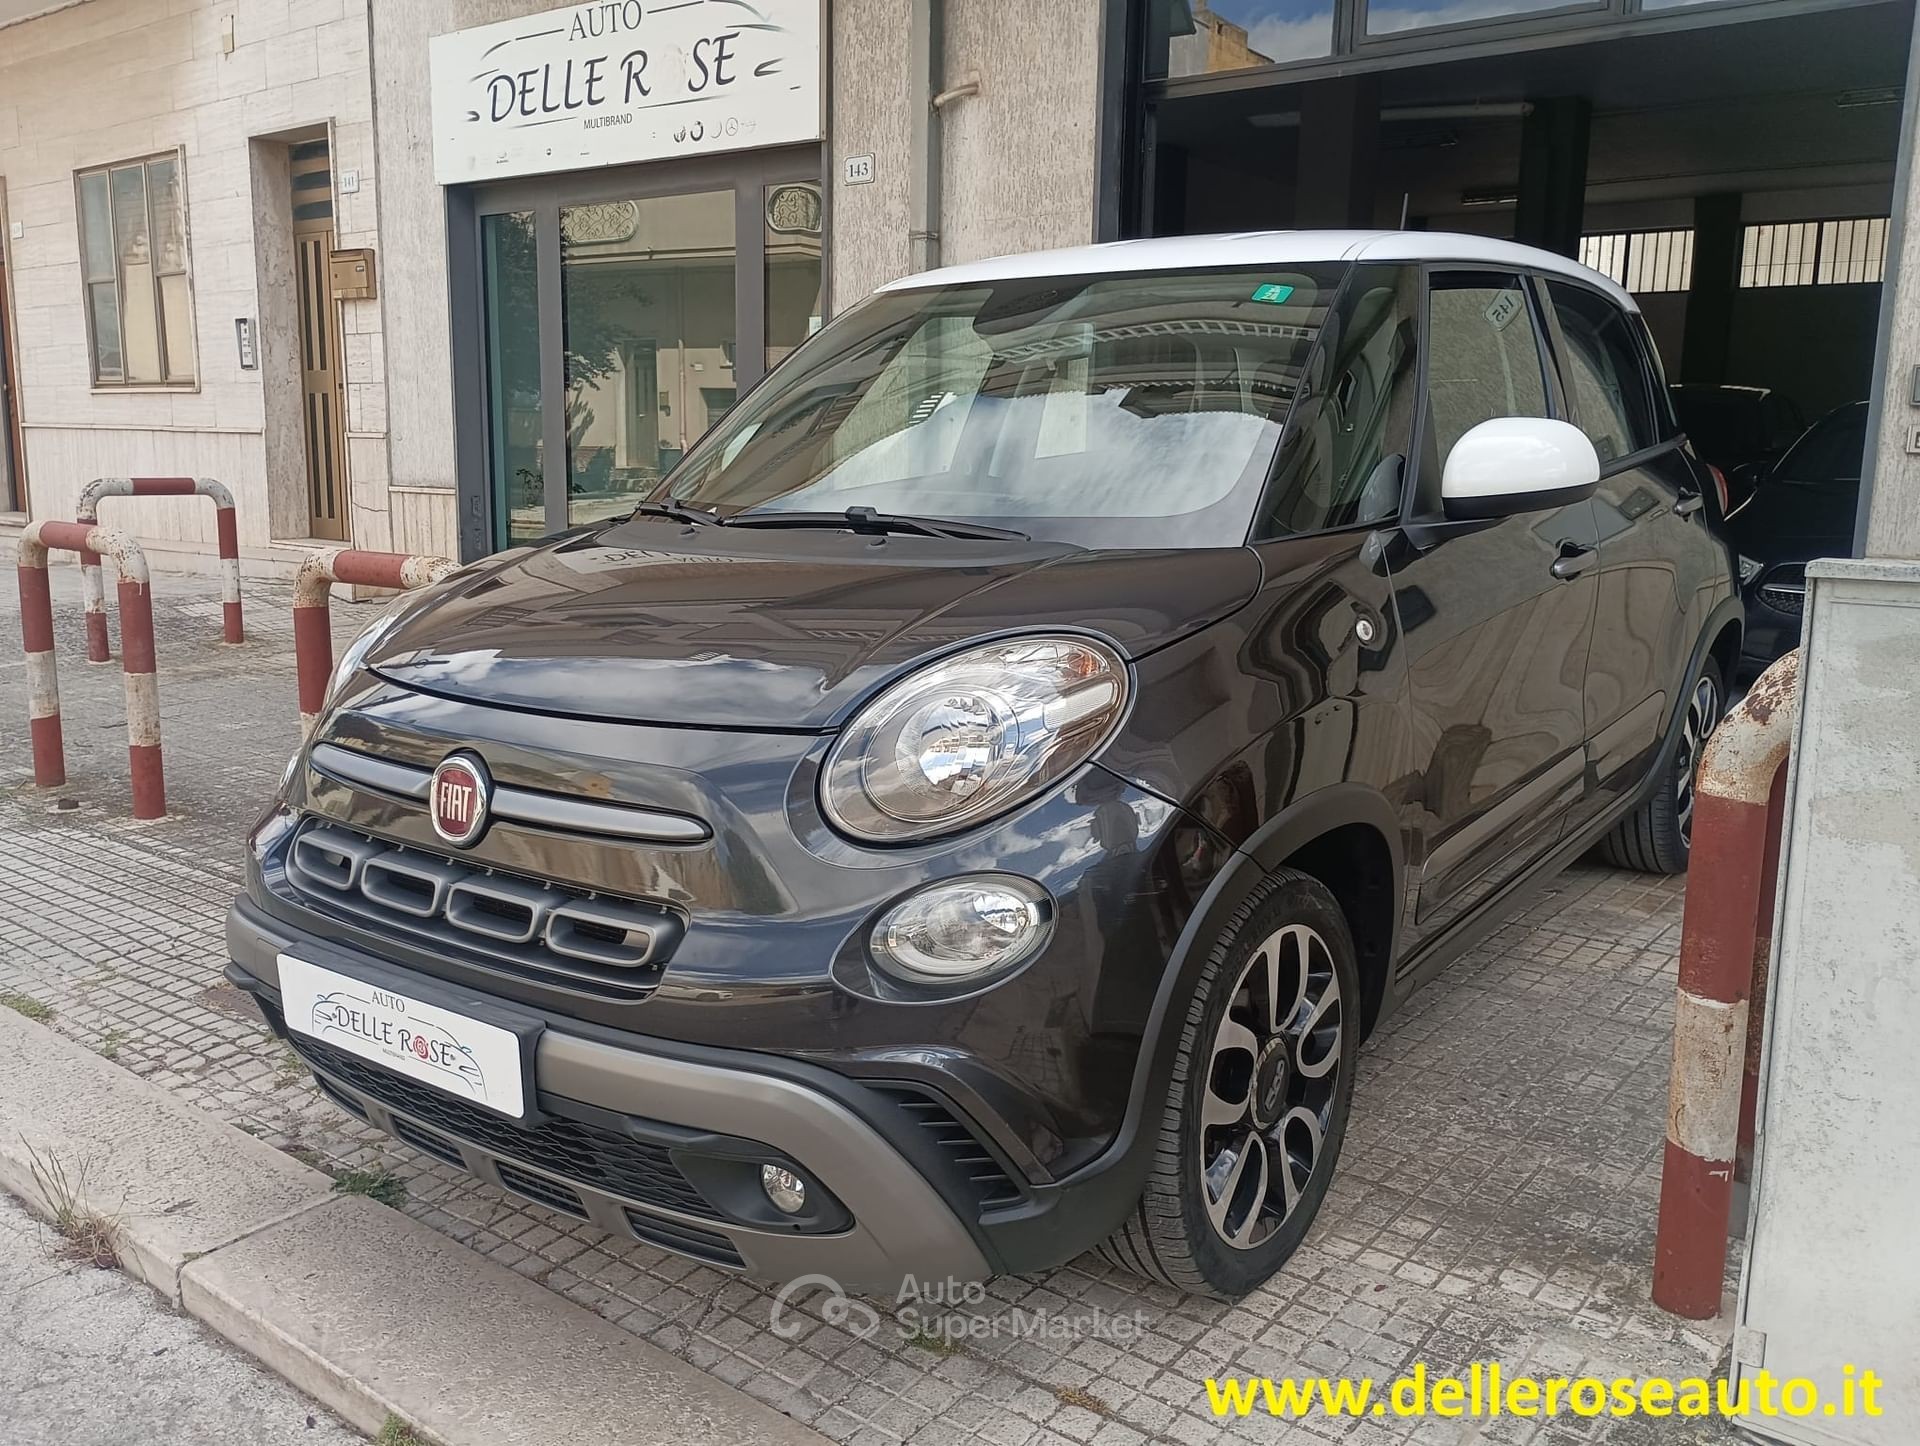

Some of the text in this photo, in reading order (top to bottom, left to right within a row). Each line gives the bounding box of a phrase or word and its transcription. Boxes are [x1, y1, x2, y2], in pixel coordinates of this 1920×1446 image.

[569, 0, 643, 42] AUTO
[487, 55, 608, 123] DELLE
[583, 113, 633, 130] MULTIBRAND
[849, 162, 869, 177] 143
[440, 781, 473, 823] FIAT
[371, 990, 406, 1013] AUTO
[335, 1005, 393, 1046] DELLE
